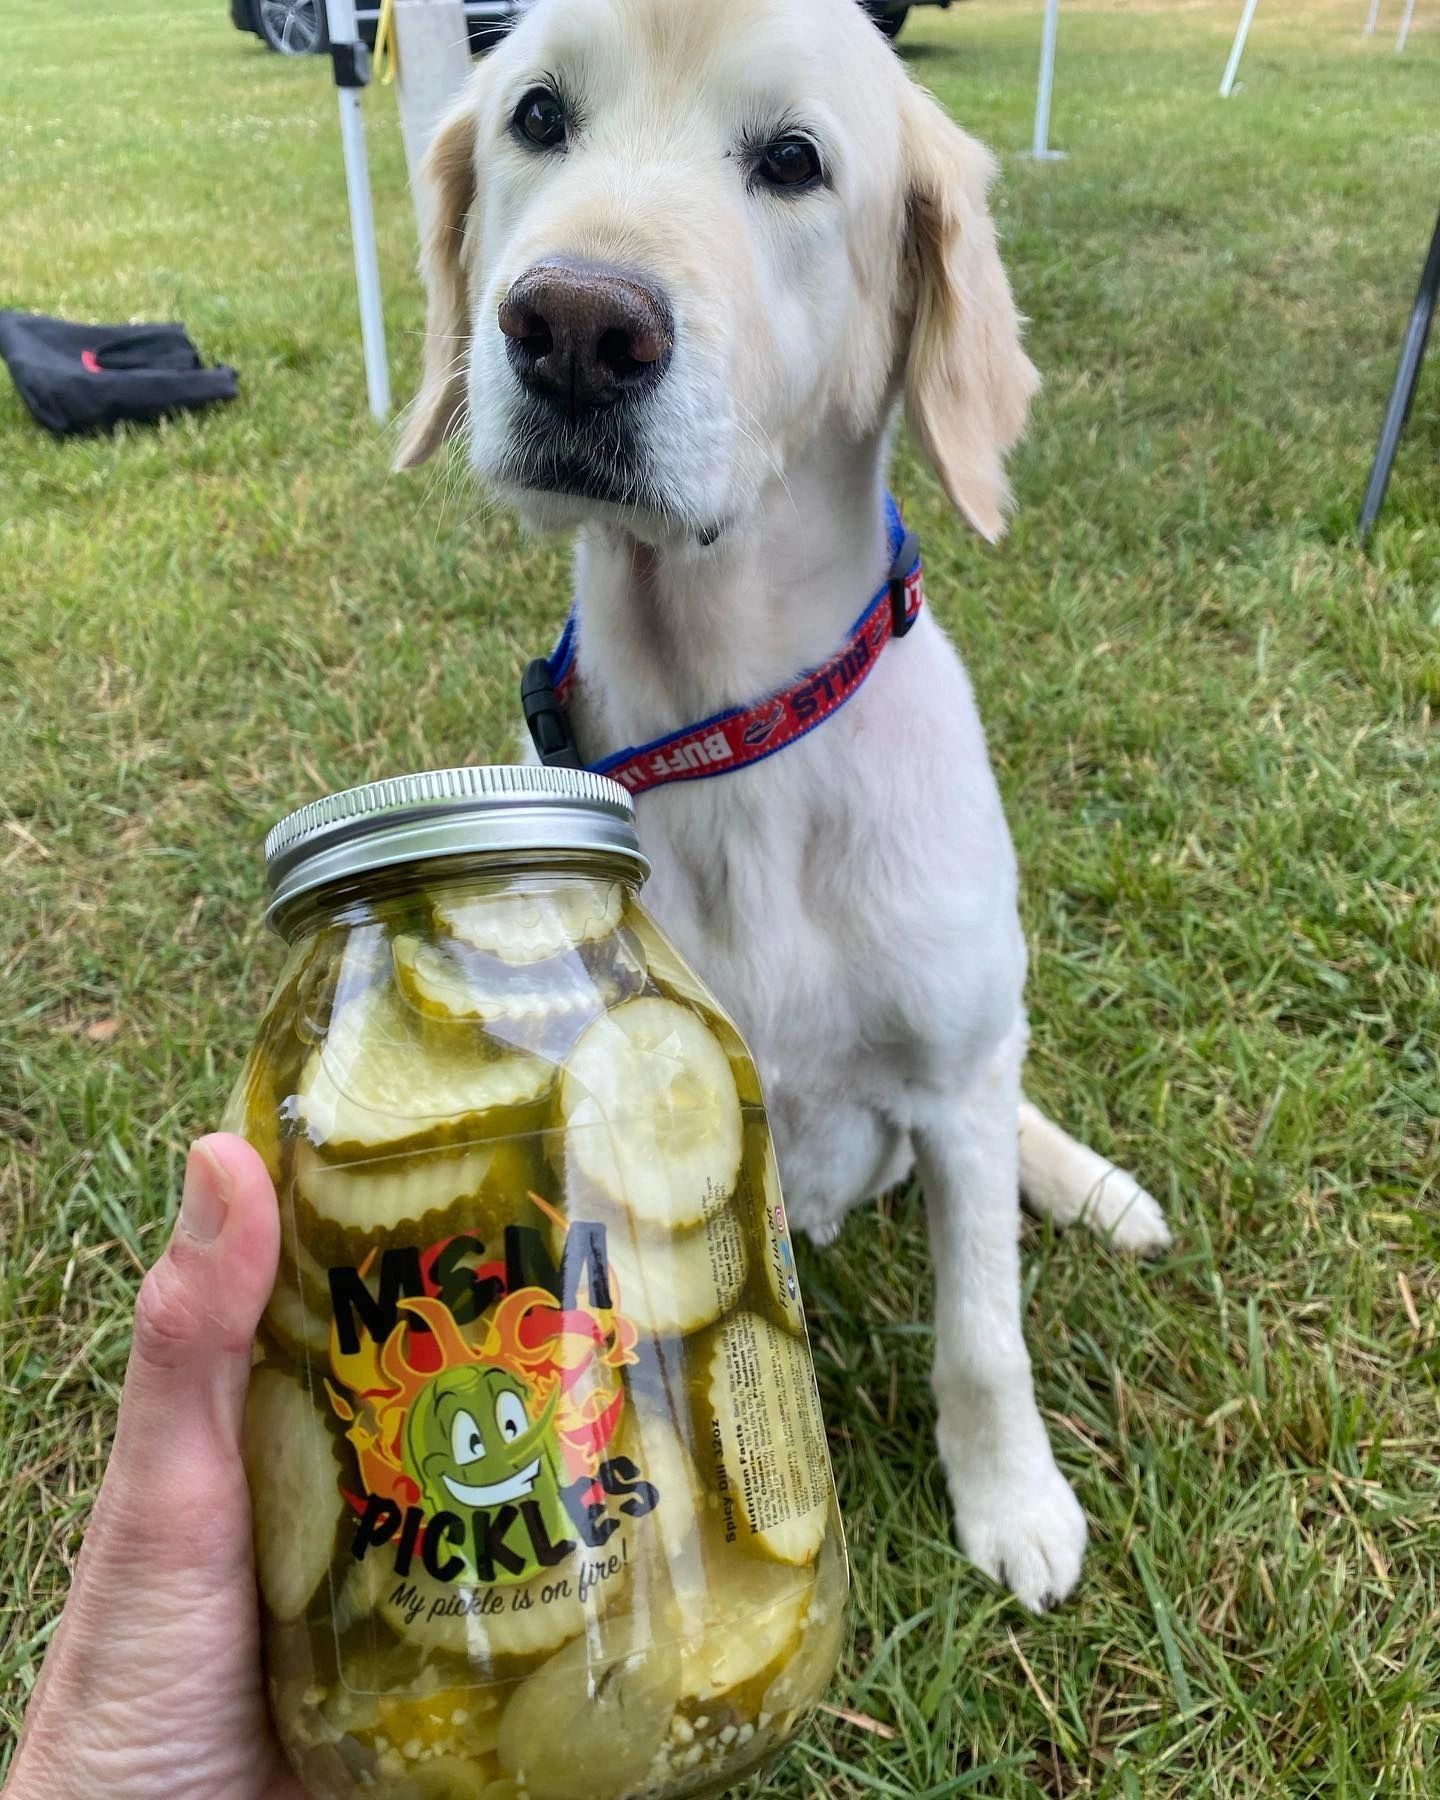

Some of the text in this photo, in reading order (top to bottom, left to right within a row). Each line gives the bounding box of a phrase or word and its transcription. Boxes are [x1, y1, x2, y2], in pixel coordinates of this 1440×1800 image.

[792, 637, 869, 718] BILLS
[766, 1206, 776, 1231] on
[770, 1238, 780, 1260] us
[328, 1221, 613, 1355] M&M
[772, 1264, 788, 1309] Find
[734, 1360, 742, 1386] Total
[740, 1350, 749, 1387] Sodium
[749, 1361, 758, 1398] Protein
[735, 1423, 746, 1464] Facts
[712, 1419, 736, 1543] Spicy Dill 32oz
[748, 1449, 759, 1493] Calories
[352, 1456, 660, 1582] PICKLES
[742, 1468, 757, 1534] Nutrition
[389, 1537, 628, 1624] My pickle is on fire!
